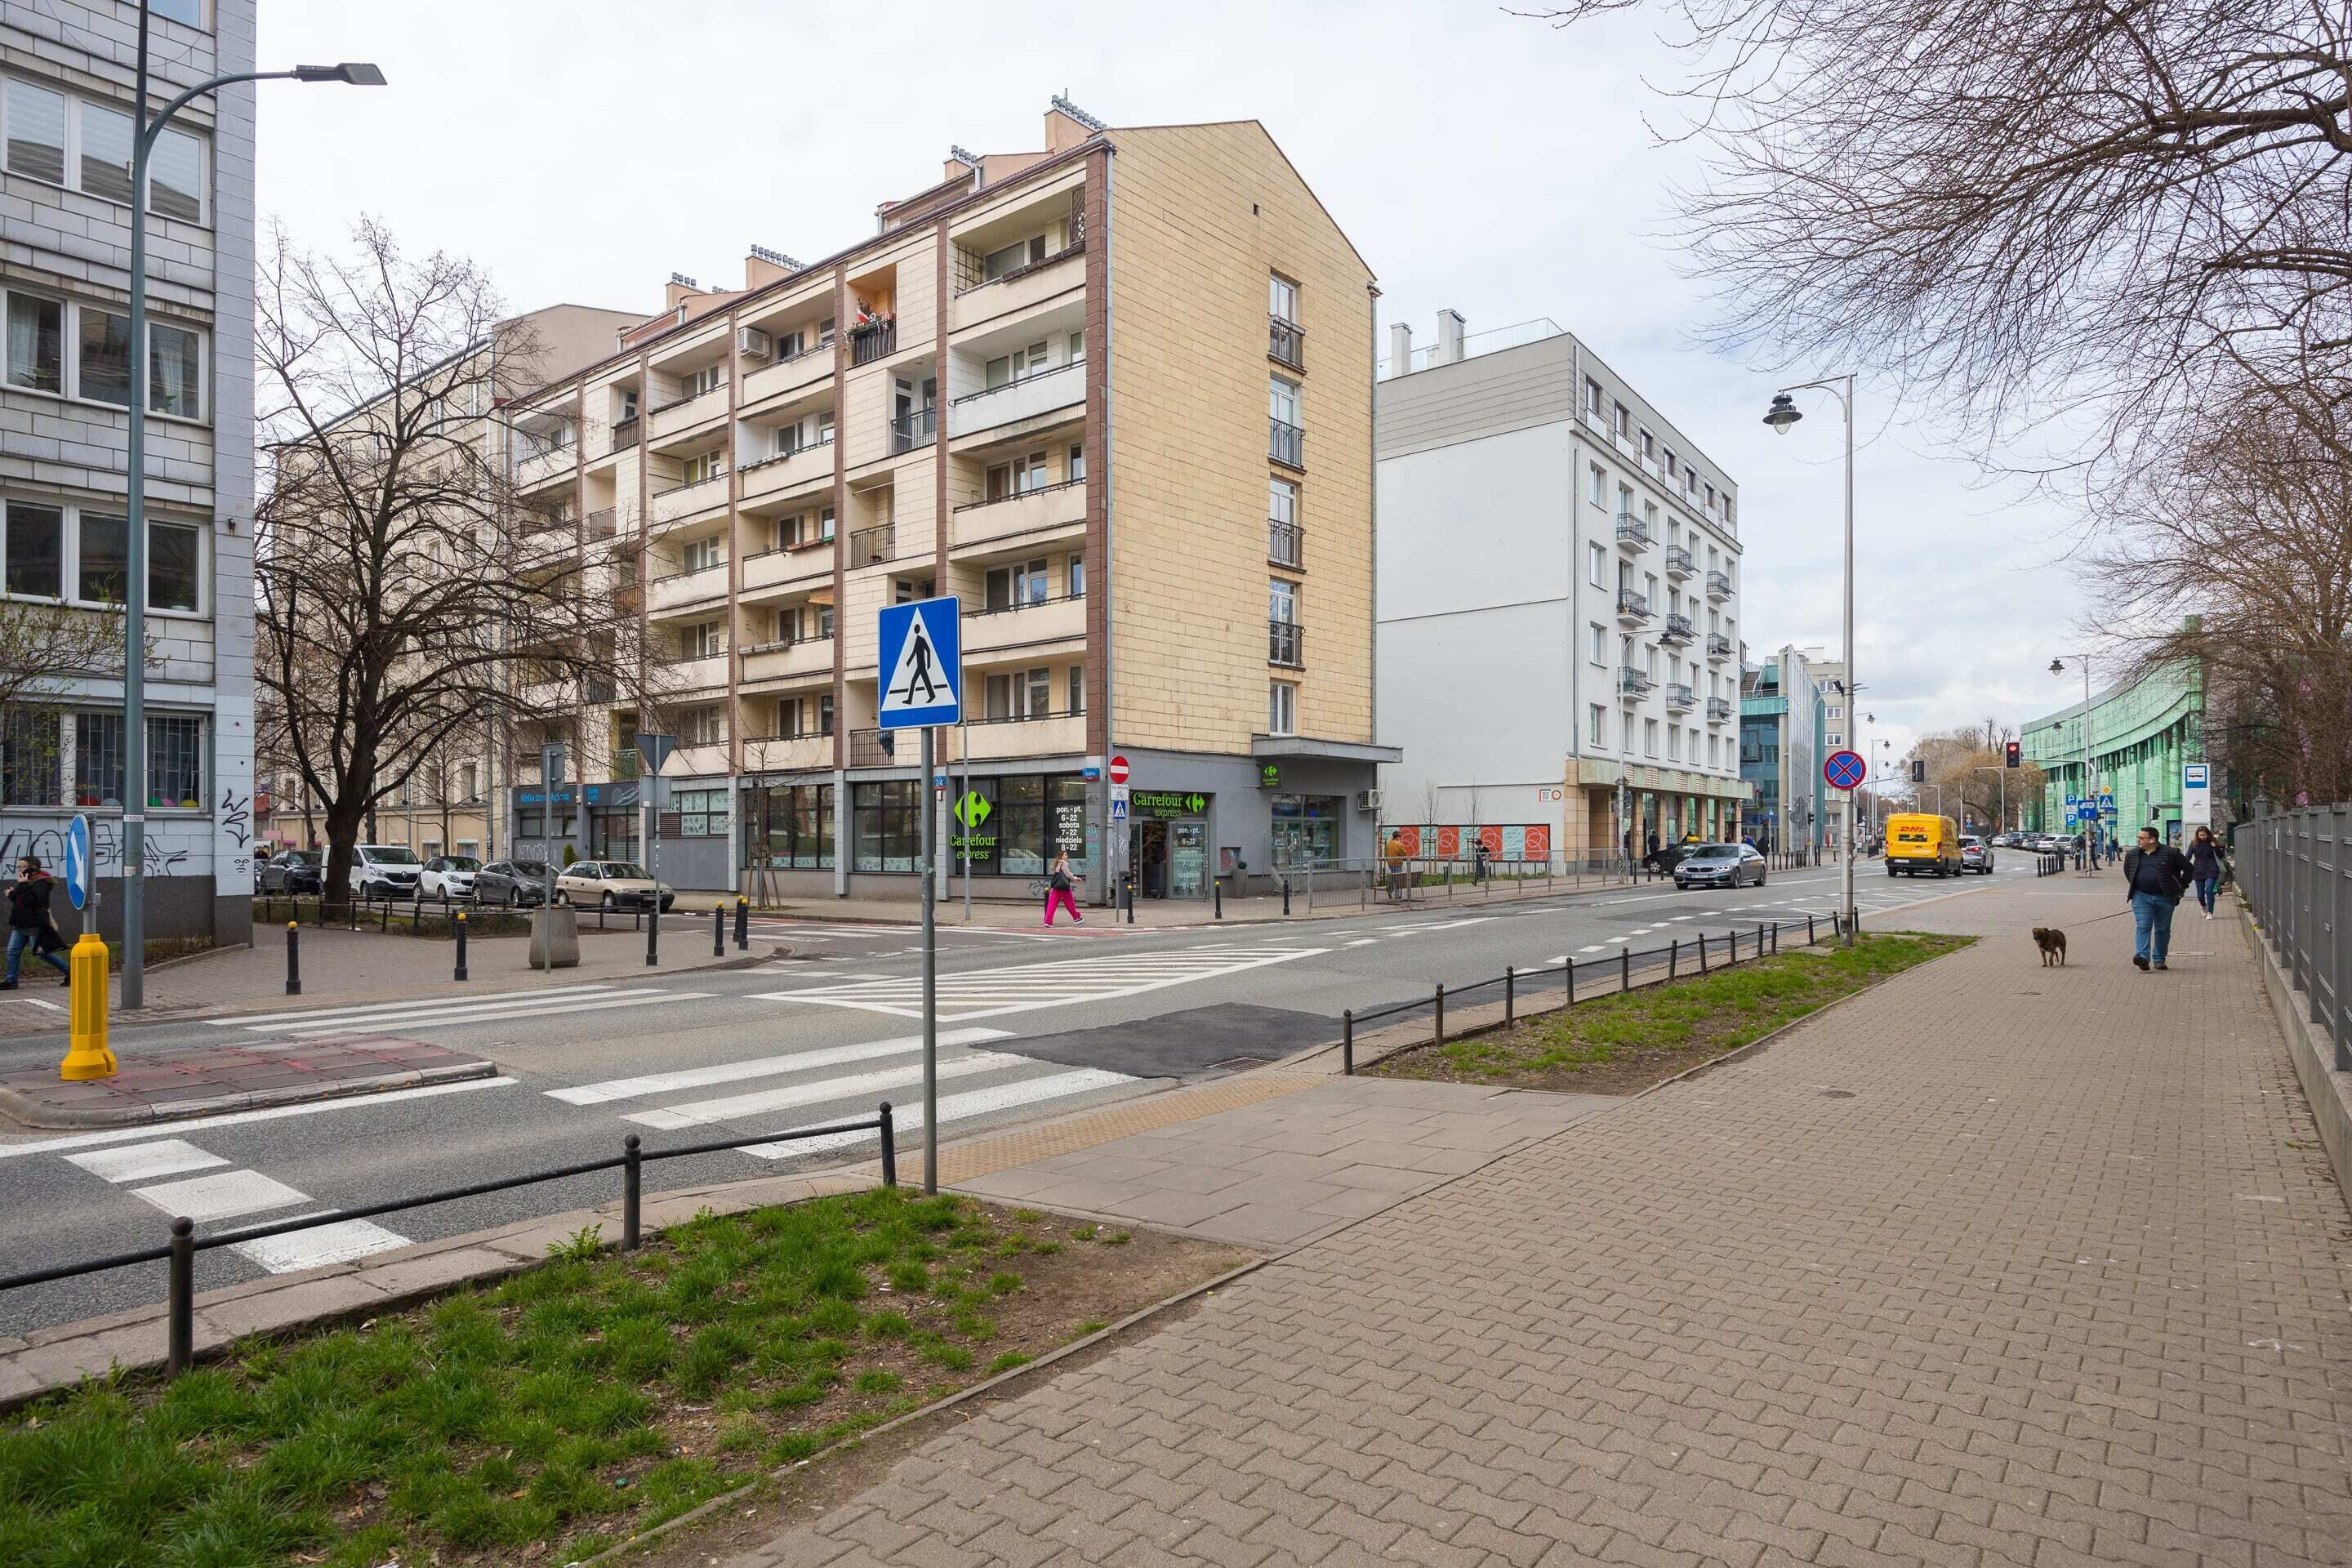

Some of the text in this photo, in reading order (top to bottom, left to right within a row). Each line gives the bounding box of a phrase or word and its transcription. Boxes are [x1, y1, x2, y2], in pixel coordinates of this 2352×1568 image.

[935, 777, 943, 786] 2/4
[1133, 792, 1183, 807] Carrefour
[1155, 808, 1183, 819] express
[950, 833, 996, 846] Carefour
